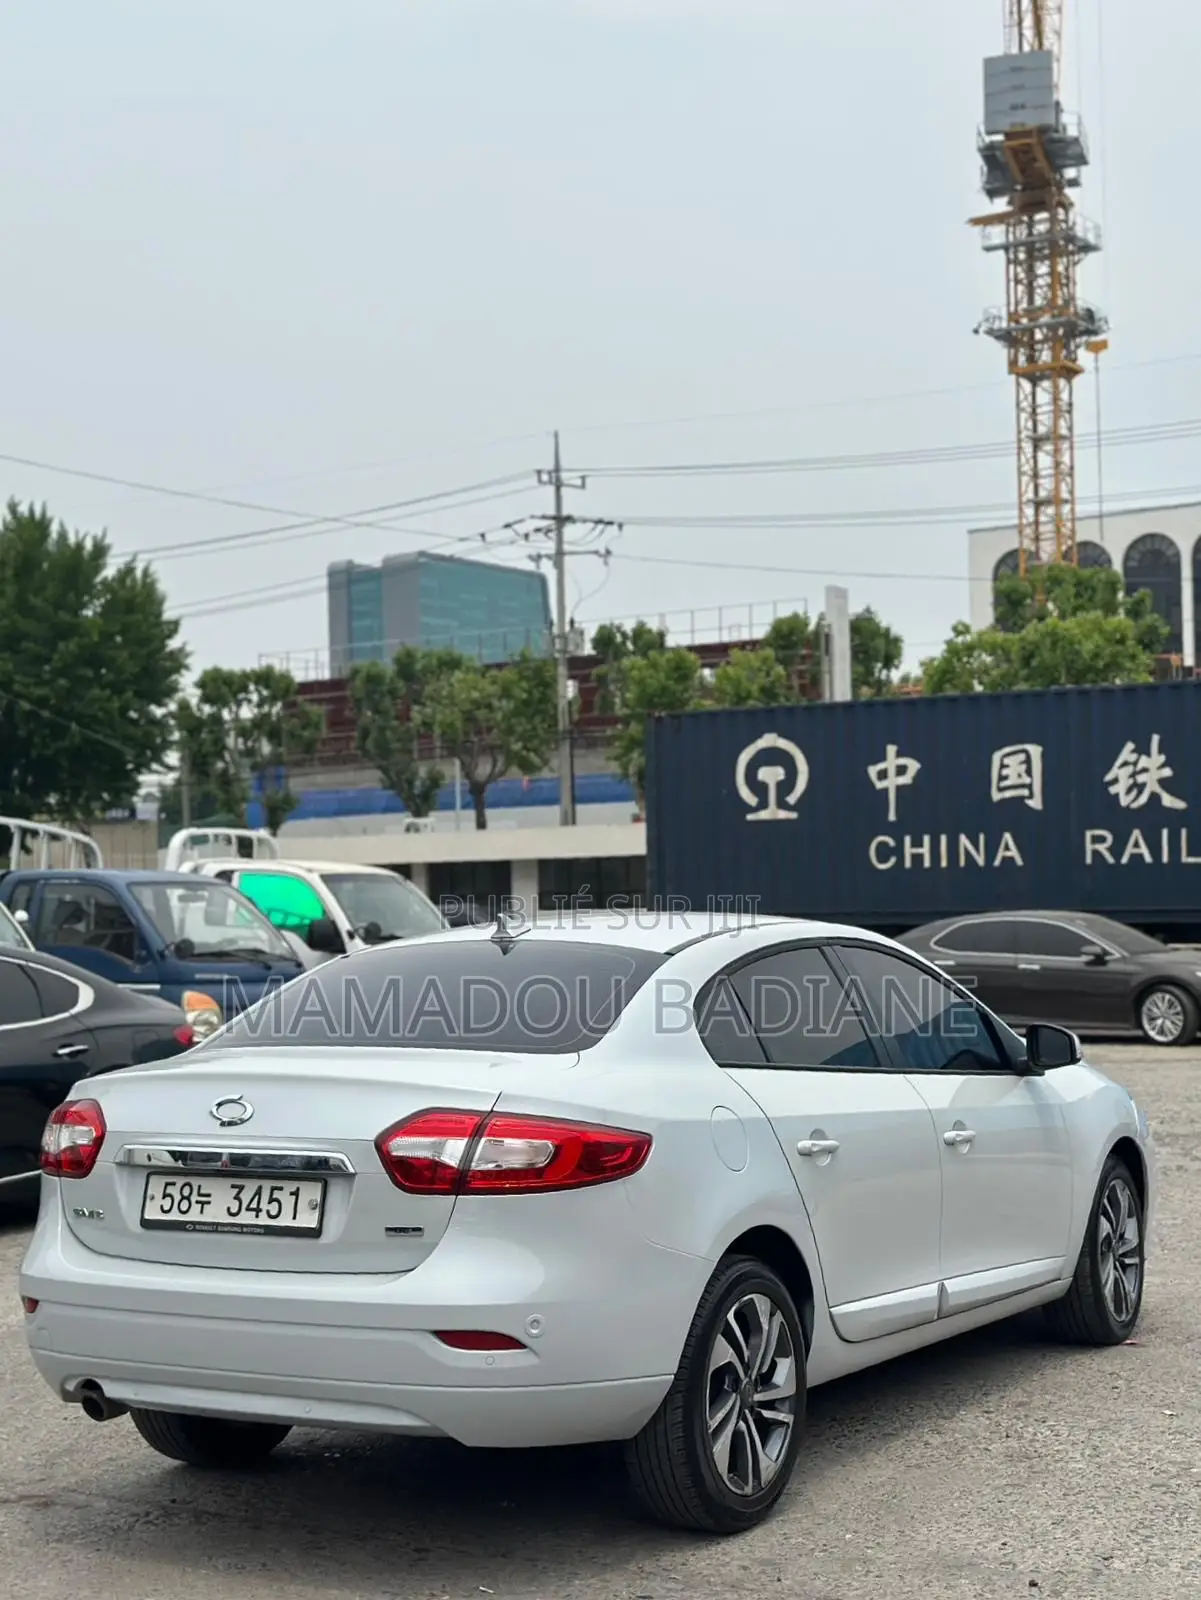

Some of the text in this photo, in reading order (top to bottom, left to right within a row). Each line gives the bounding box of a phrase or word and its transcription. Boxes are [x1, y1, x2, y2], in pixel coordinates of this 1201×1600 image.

[867, 734, 1188, 821] 中国铁
[869, 827, 1201, 870] CHINA RAIL
[160, 1181, 300, 1220] 58누 3451
